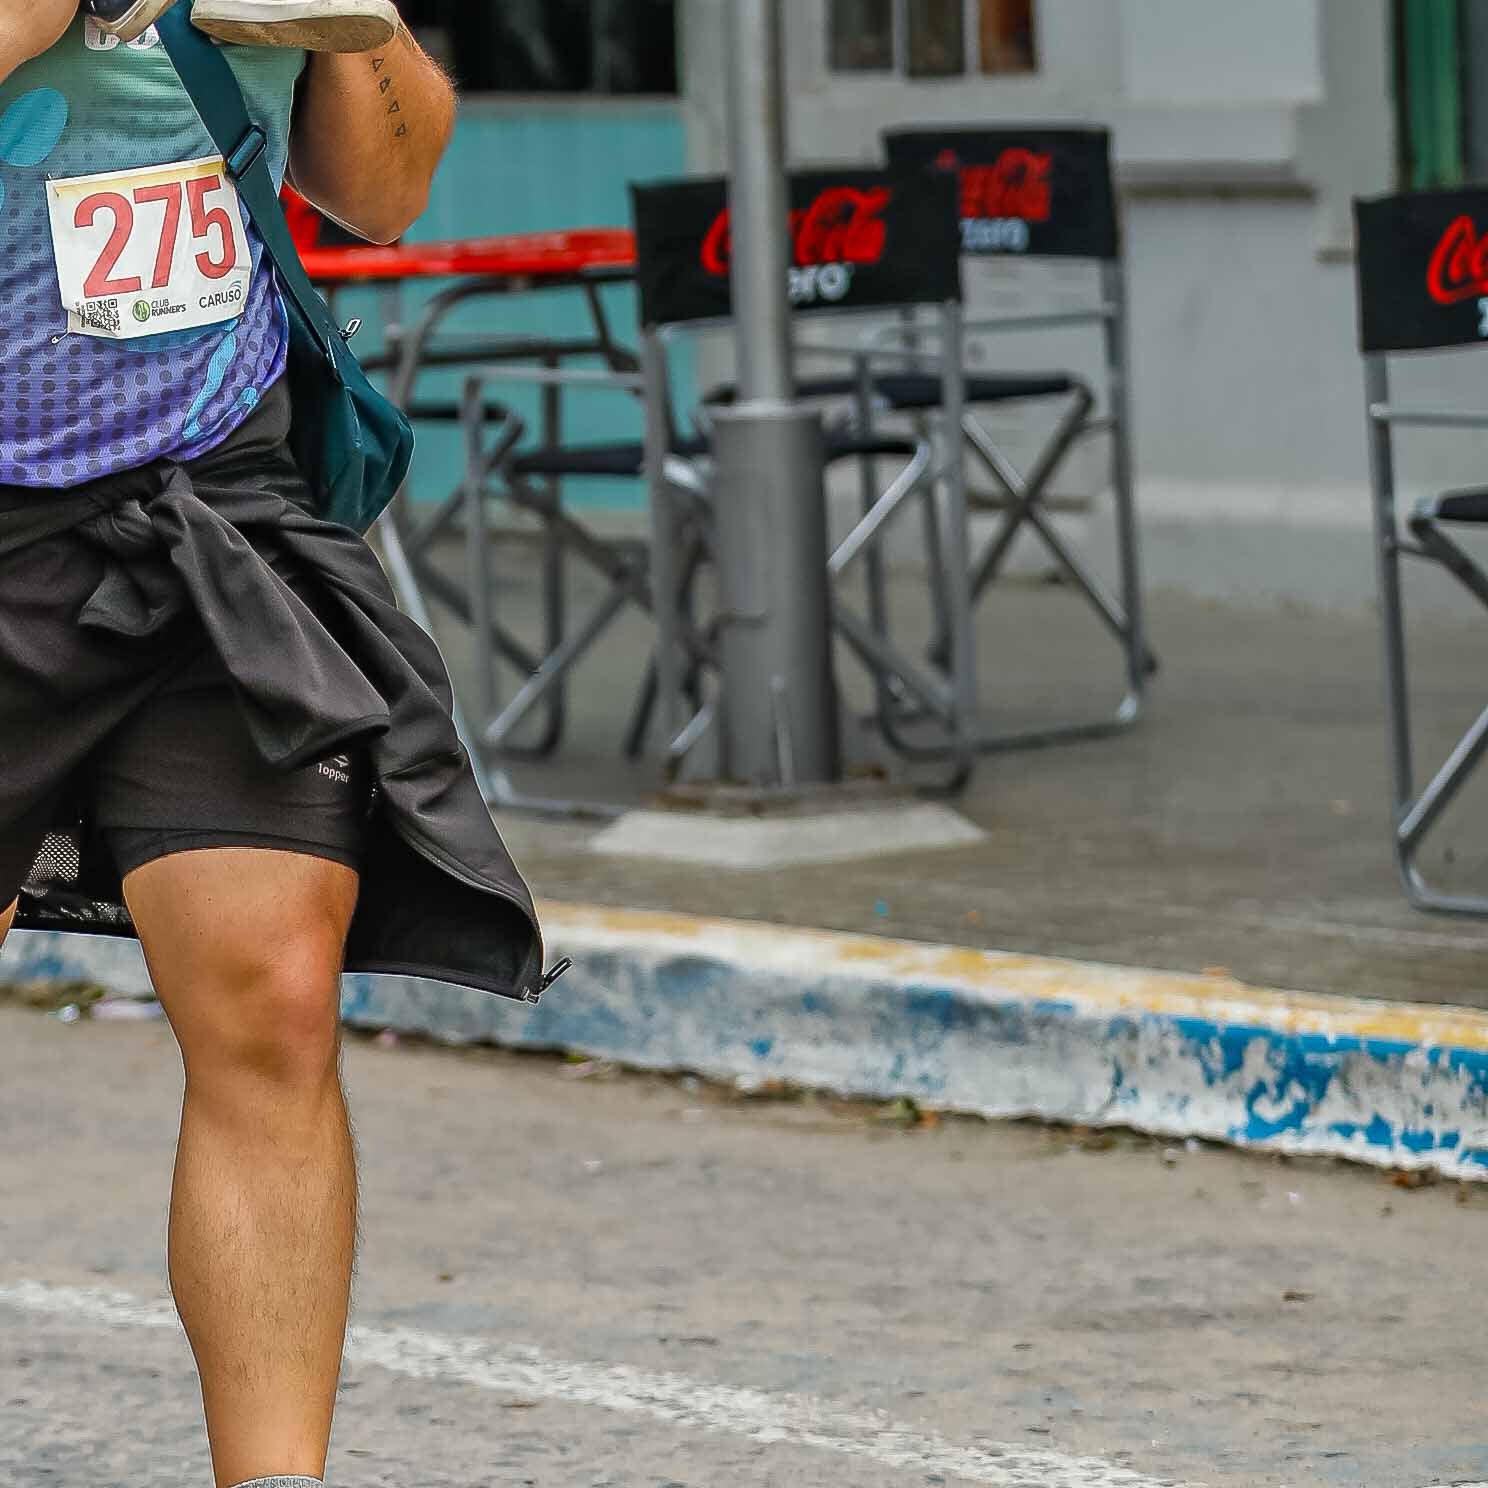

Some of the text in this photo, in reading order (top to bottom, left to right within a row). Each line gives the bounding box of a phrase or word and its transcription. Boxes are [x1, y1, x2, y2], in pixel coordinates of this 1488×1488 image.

[74, 175, 237, 298] 275
[151, 298, 170, 309] CLUB
[199, 288, 241, 308] CARUSO
[151, 303, 187, 318] RUNNER'S
